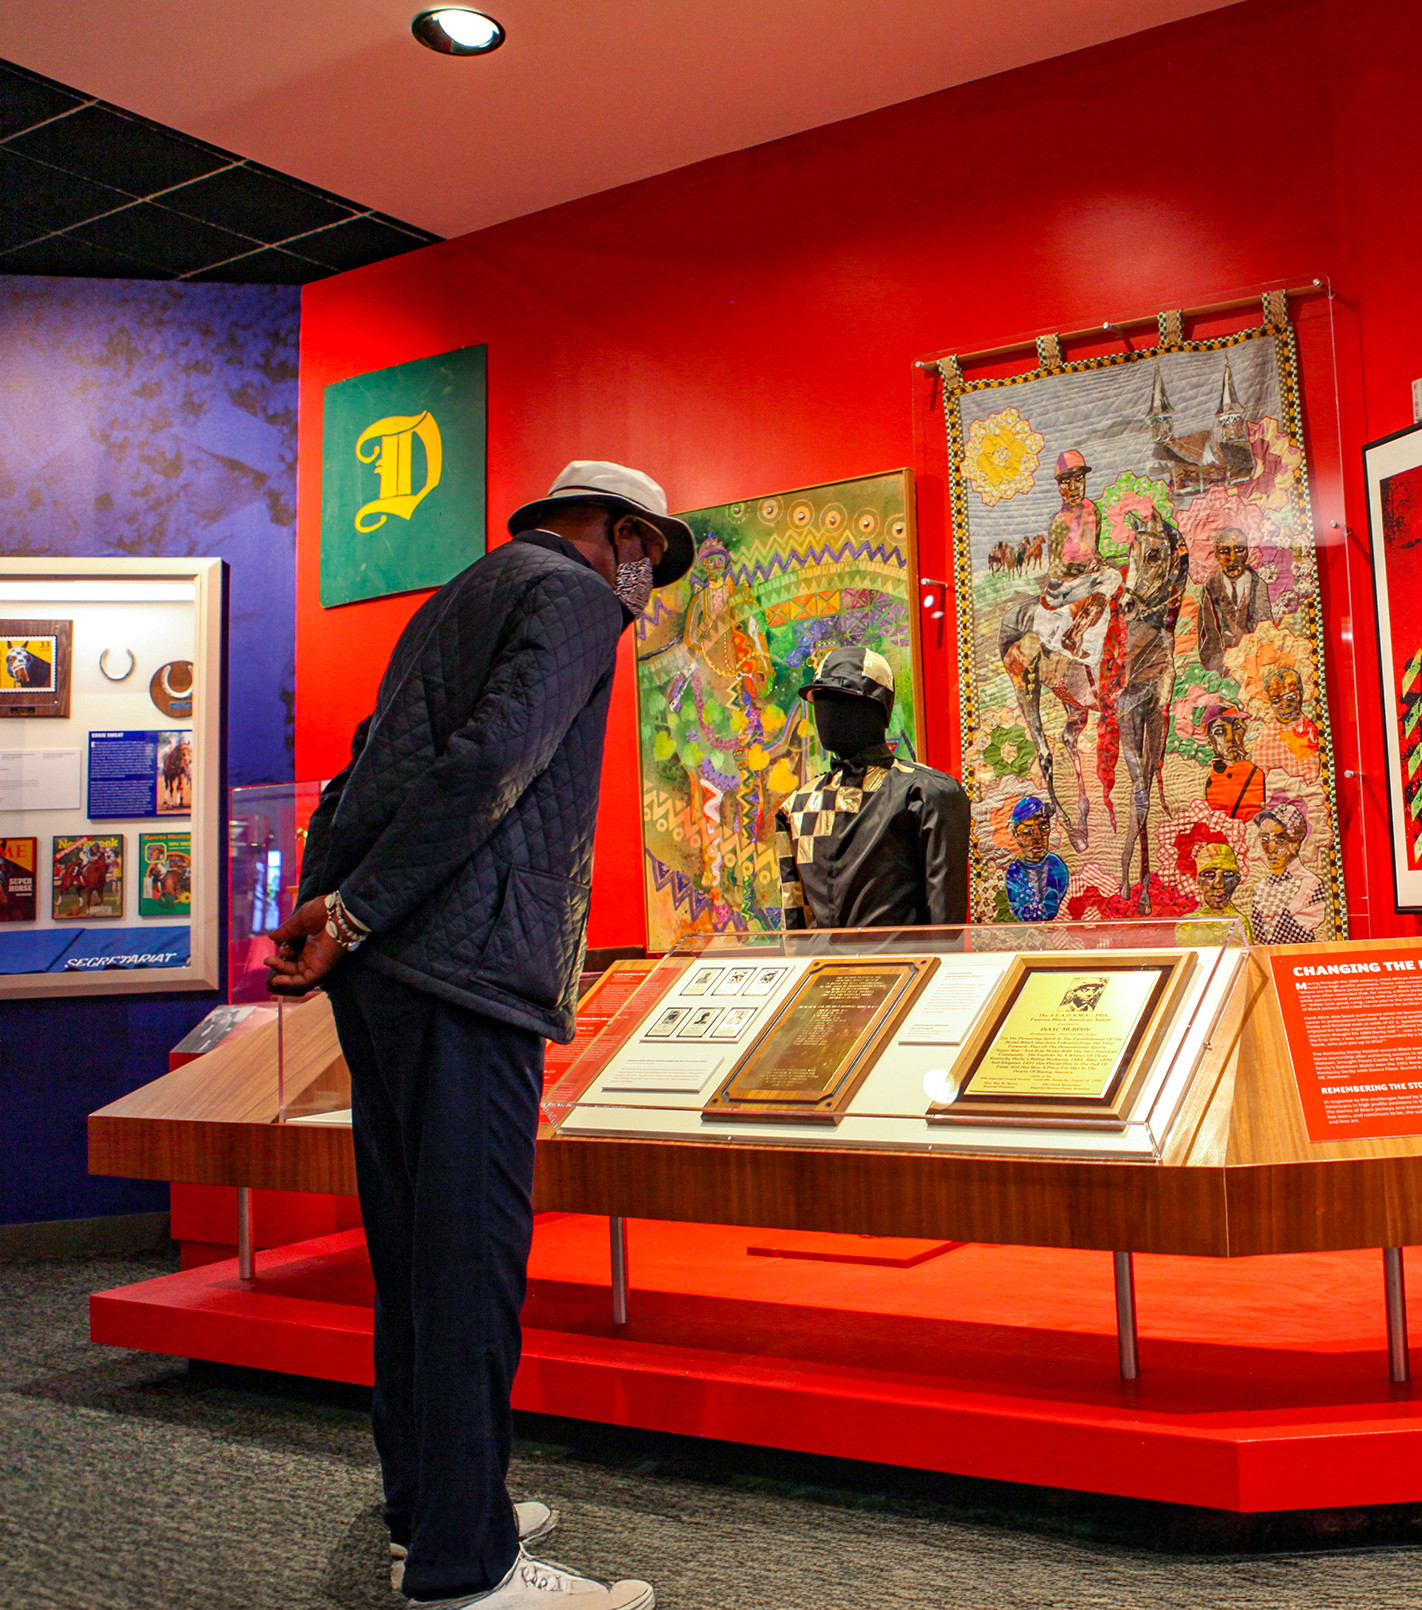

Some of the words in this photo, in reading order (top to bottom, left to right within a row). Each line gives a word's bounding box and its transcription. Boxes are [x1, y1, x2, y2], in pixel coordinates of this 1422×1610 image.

[354, 409, 443, 533] D
[58, 837, 119, 849] Nesweek
[64, 952, 177, 968] SECRETARIAT
[1293, 962, 1380, 976] CHANGING
[1382, 960, 1416, 971] THE
[1321, 1084, 1388, 1094] REMEMBERING
[1388, 1082, 1406, 1090] THE
